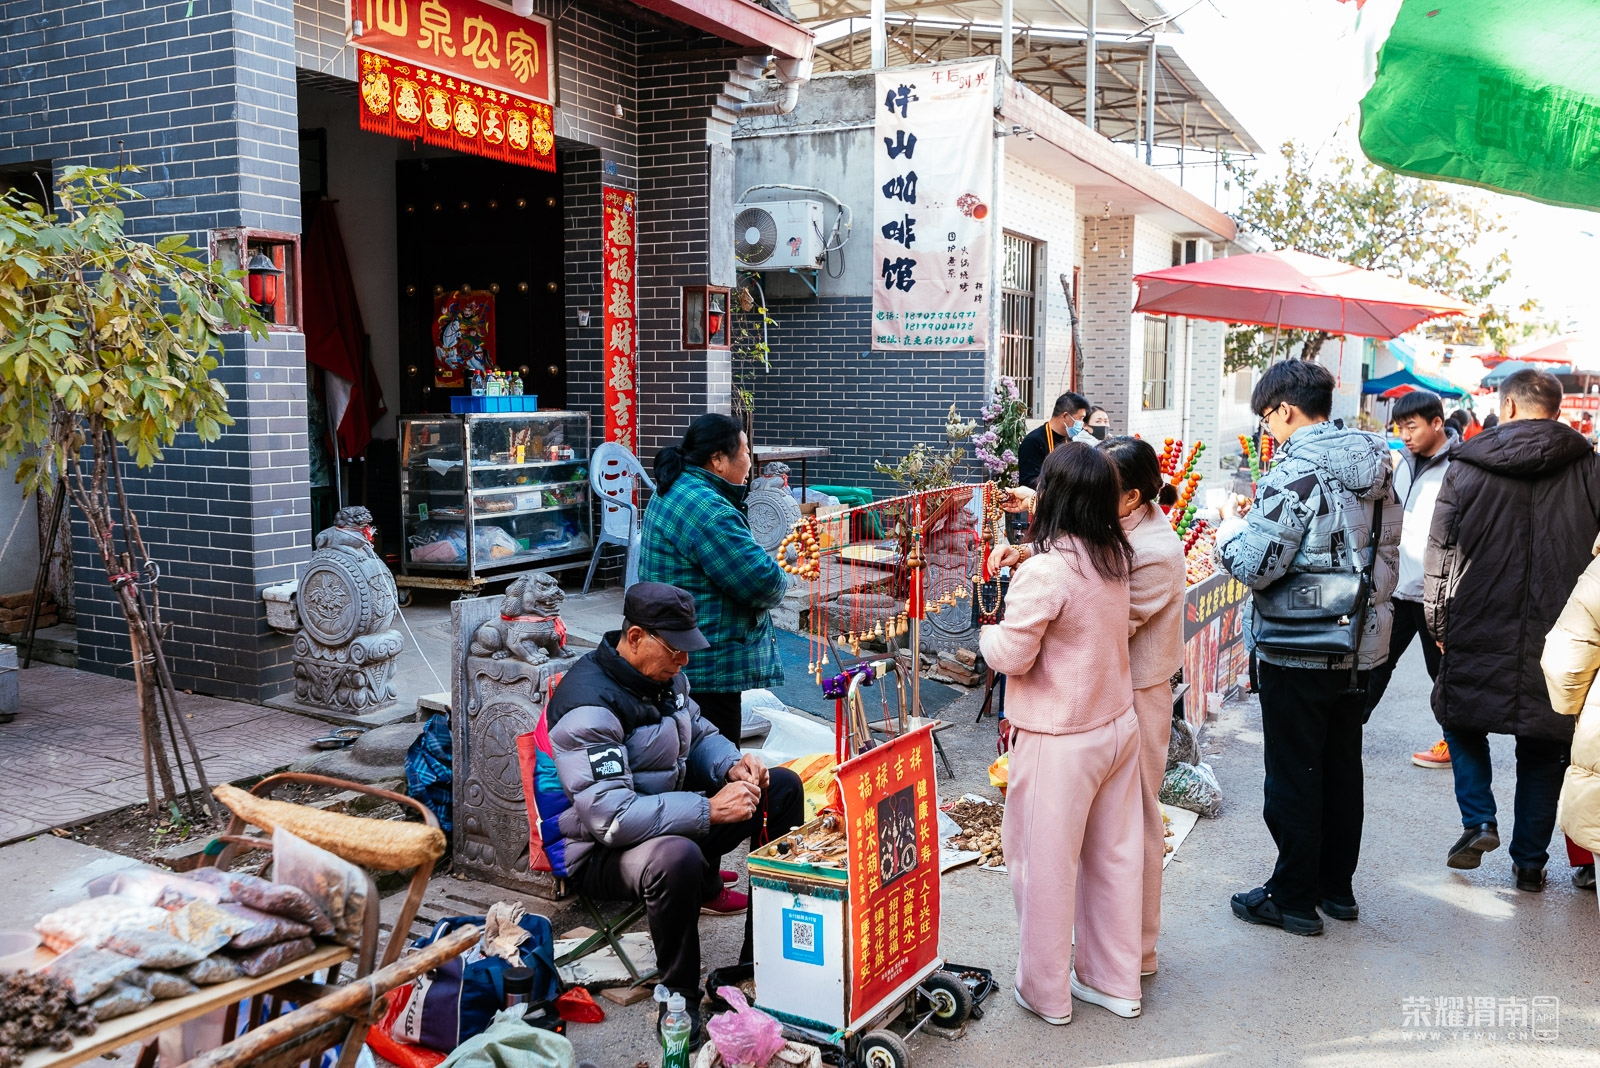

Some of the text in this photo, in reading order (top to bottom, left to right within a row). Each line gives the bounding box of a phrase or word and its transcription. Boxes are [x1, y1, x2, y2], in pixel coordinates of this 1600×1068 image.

[931, 68, 989, 89] 午后时光
[881, 83, 919, 293] 伴山咖啡馆
[857, 747, 923, 801] 福禄吉祥
[863, 805, 881, 899] 桃木葫芦
[916, 777, 932, 865] 健康长寿
